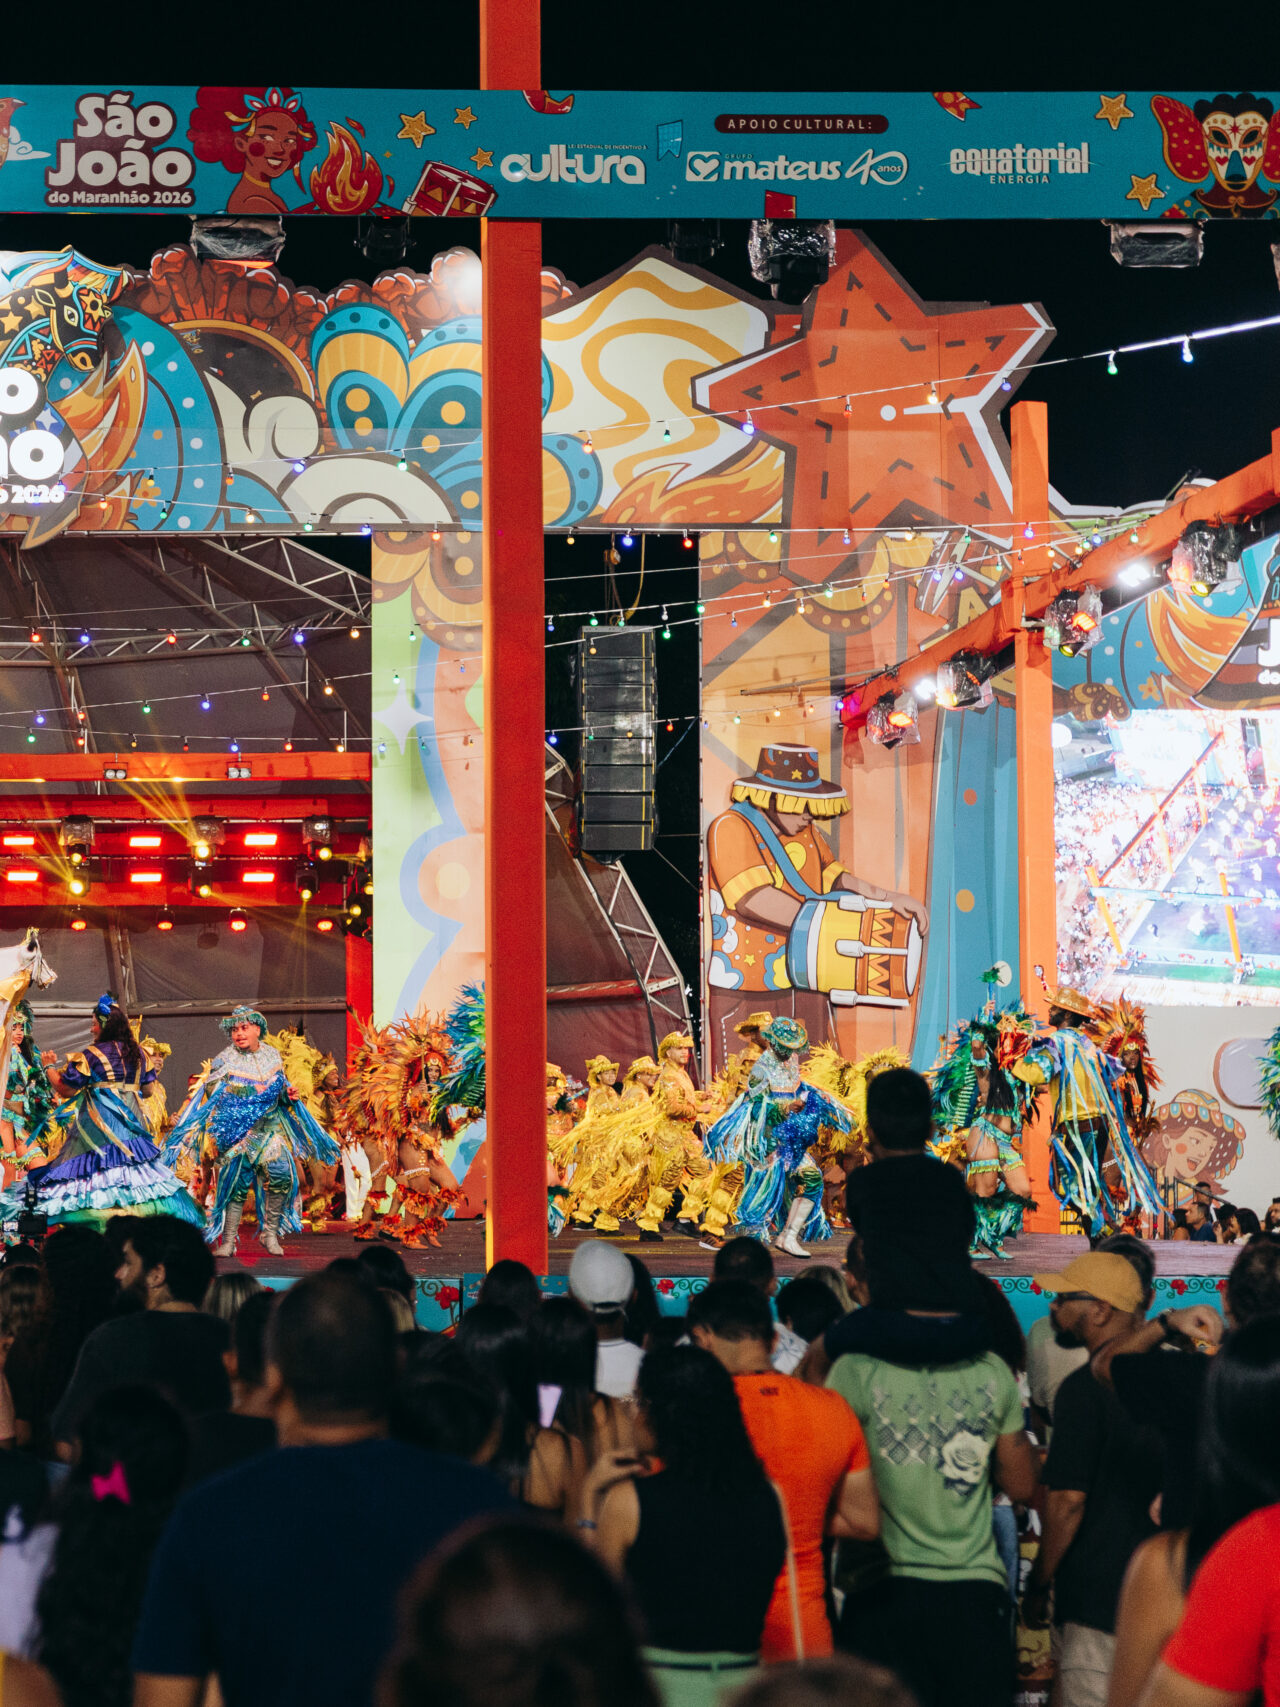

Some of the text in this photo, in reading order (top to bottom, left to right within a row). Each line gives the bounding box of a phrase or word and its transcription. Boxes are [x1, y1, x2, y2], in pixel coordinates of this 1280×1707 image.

[77, 93, 173, 138] São
[728, 118, 873, 130] APOIO CULTURAL:
[48, 138, 193, 187] João
[500, 144, 646, 184] cultura
[723, 155, 842, 181] mateus
[877, 164, 902, 173] anos
[949, 142, 1089, 176] equatorial
[989, 175, 1050, 184] ENERGIA
[48, 190, 192, 205] do Maranhão 2026
[11, 484, 65, 504] 2026
